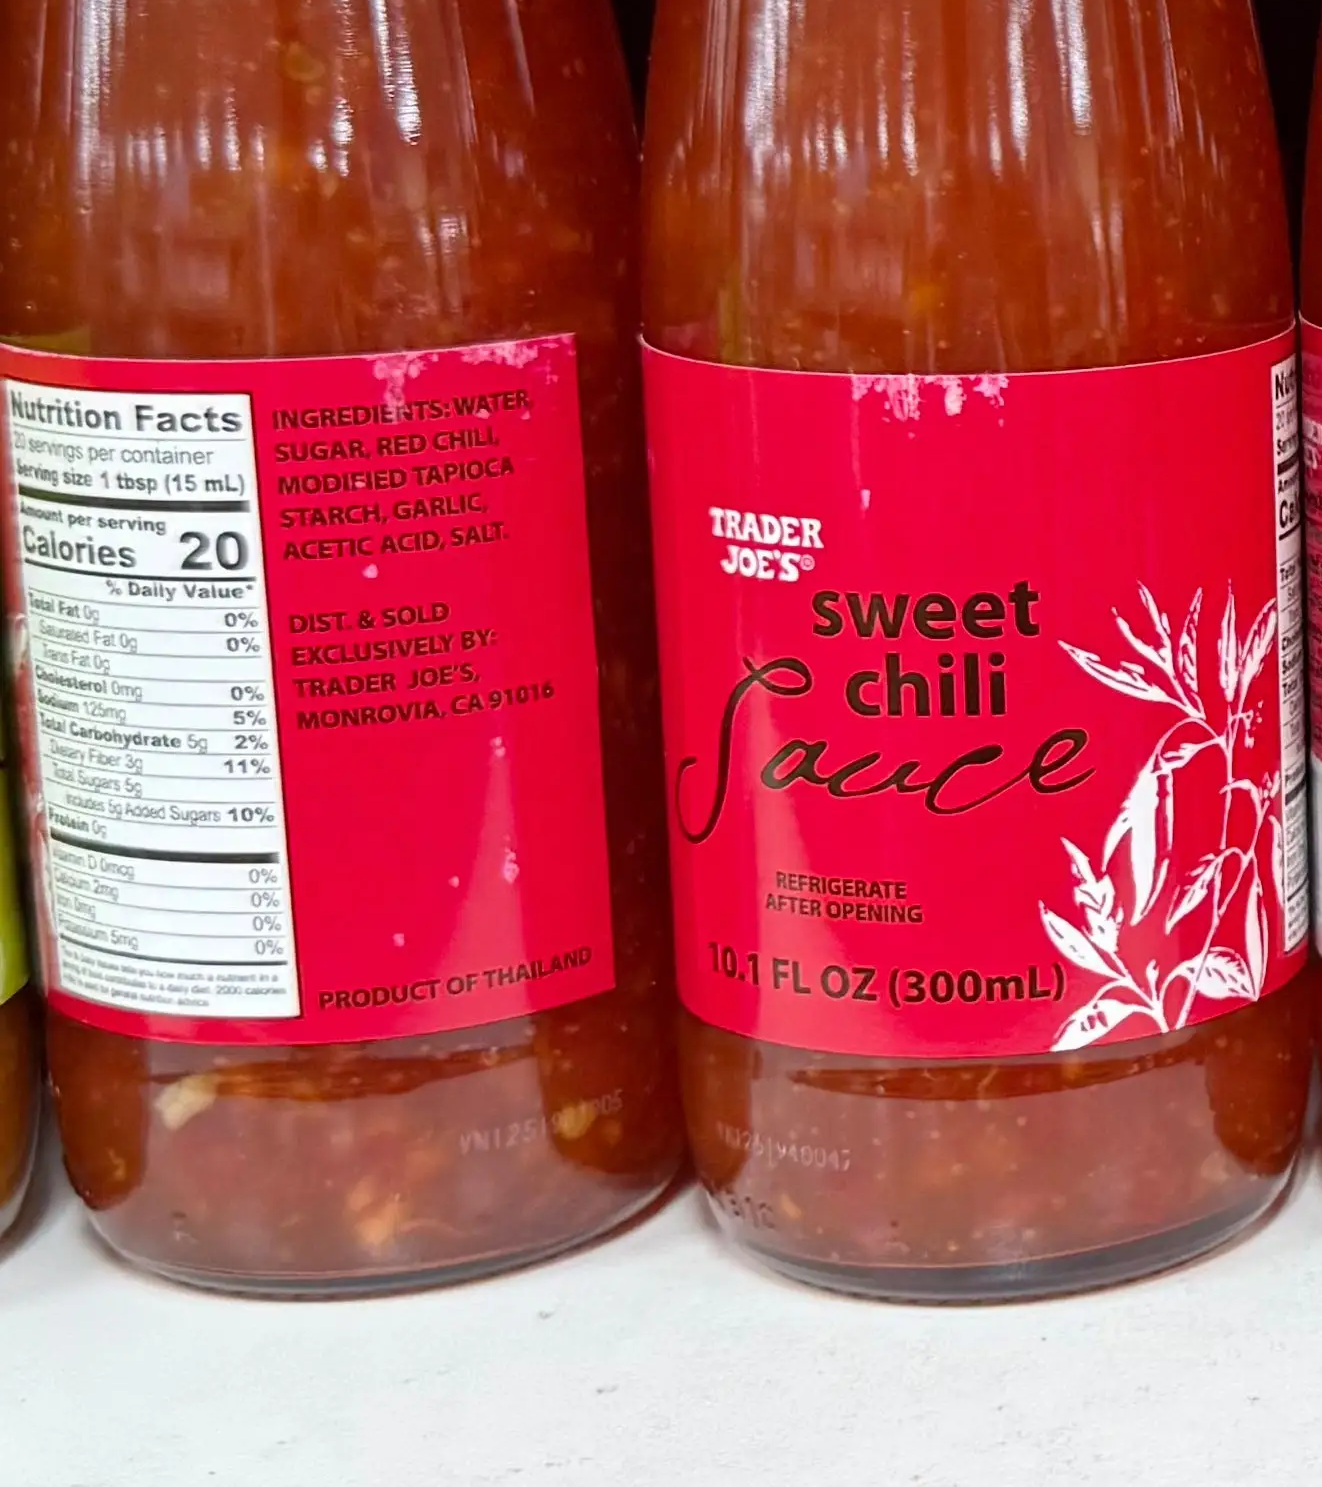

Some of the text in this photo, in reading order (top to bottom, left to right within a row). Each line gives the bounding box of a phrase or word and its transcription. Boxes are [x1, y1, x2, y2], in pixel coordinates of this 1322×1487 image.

[10, 390, 243, 433] Nutrition Facts
[272, 389, 534, 430] INGREDIENTS: WATER,
[29, 436, 83, 463] servings
[88, 448, 115, 465] per
[121, 447, 213, 465] container
[275, 440, 371, 463] SUGAR,
[377, 433, 426, 456] RED
[16, 459, 245, 495] Serving size 1 tbsp (15 mL)
[278, 456, 515, 495] MODIFIED TAPIOCA
[68, 512, 91, 528] per
[98, 515, 167, 535] serving
[280, 492, 488, 529] STARCH, GARLIC,
[283, 521, 509, 561] ACETIC ACID, SALT.
[709, 507, 824, 549] TRADER
[23, 525, 249, 571] Calories 20
[128, 581, 176, 601] Daily
[225, 613, 258, 628] 0%
[289, 602, 450, 635] DIST. & SOLD
[812, 580, 1041, 640] sweet
[226, 637, 260, 653] 0%
[292, 628, 498, 666] EXCLUSIVELY BY:
[231, 686, 264, 701] 0%
[293, 673, 396, 698] TRADER
[845, 652, 1007, 717] chili
[233, 710, 266, 726] 5%
[296, 680, 555, 730] MONROVIA, CA 91016
[69, 719, 181, 750] Carbohydrate
[187, 734, 208, 754] 5g
[235, 735, 268, 750] 2%
[675, 655, 1096, 845] Sauce
[224, 759, 270, 774] 11%
[228, 807, 275, 823] 10%
[249, 868, 277, 883] 0%
[776, 871, 907, 900] REFRIGERATE
[251, 892, 279, 907] 0%
[765, 892, 924, 924] AFTER OPENING
[252, 916, 281, 931] 0%
[255, 940, 283, 955] 0%
[318, 945, 593, 1010] PRODUCT OF THAILAND
[708, 942, 1066, 1008] 10.1 FL OZ (300mL)
